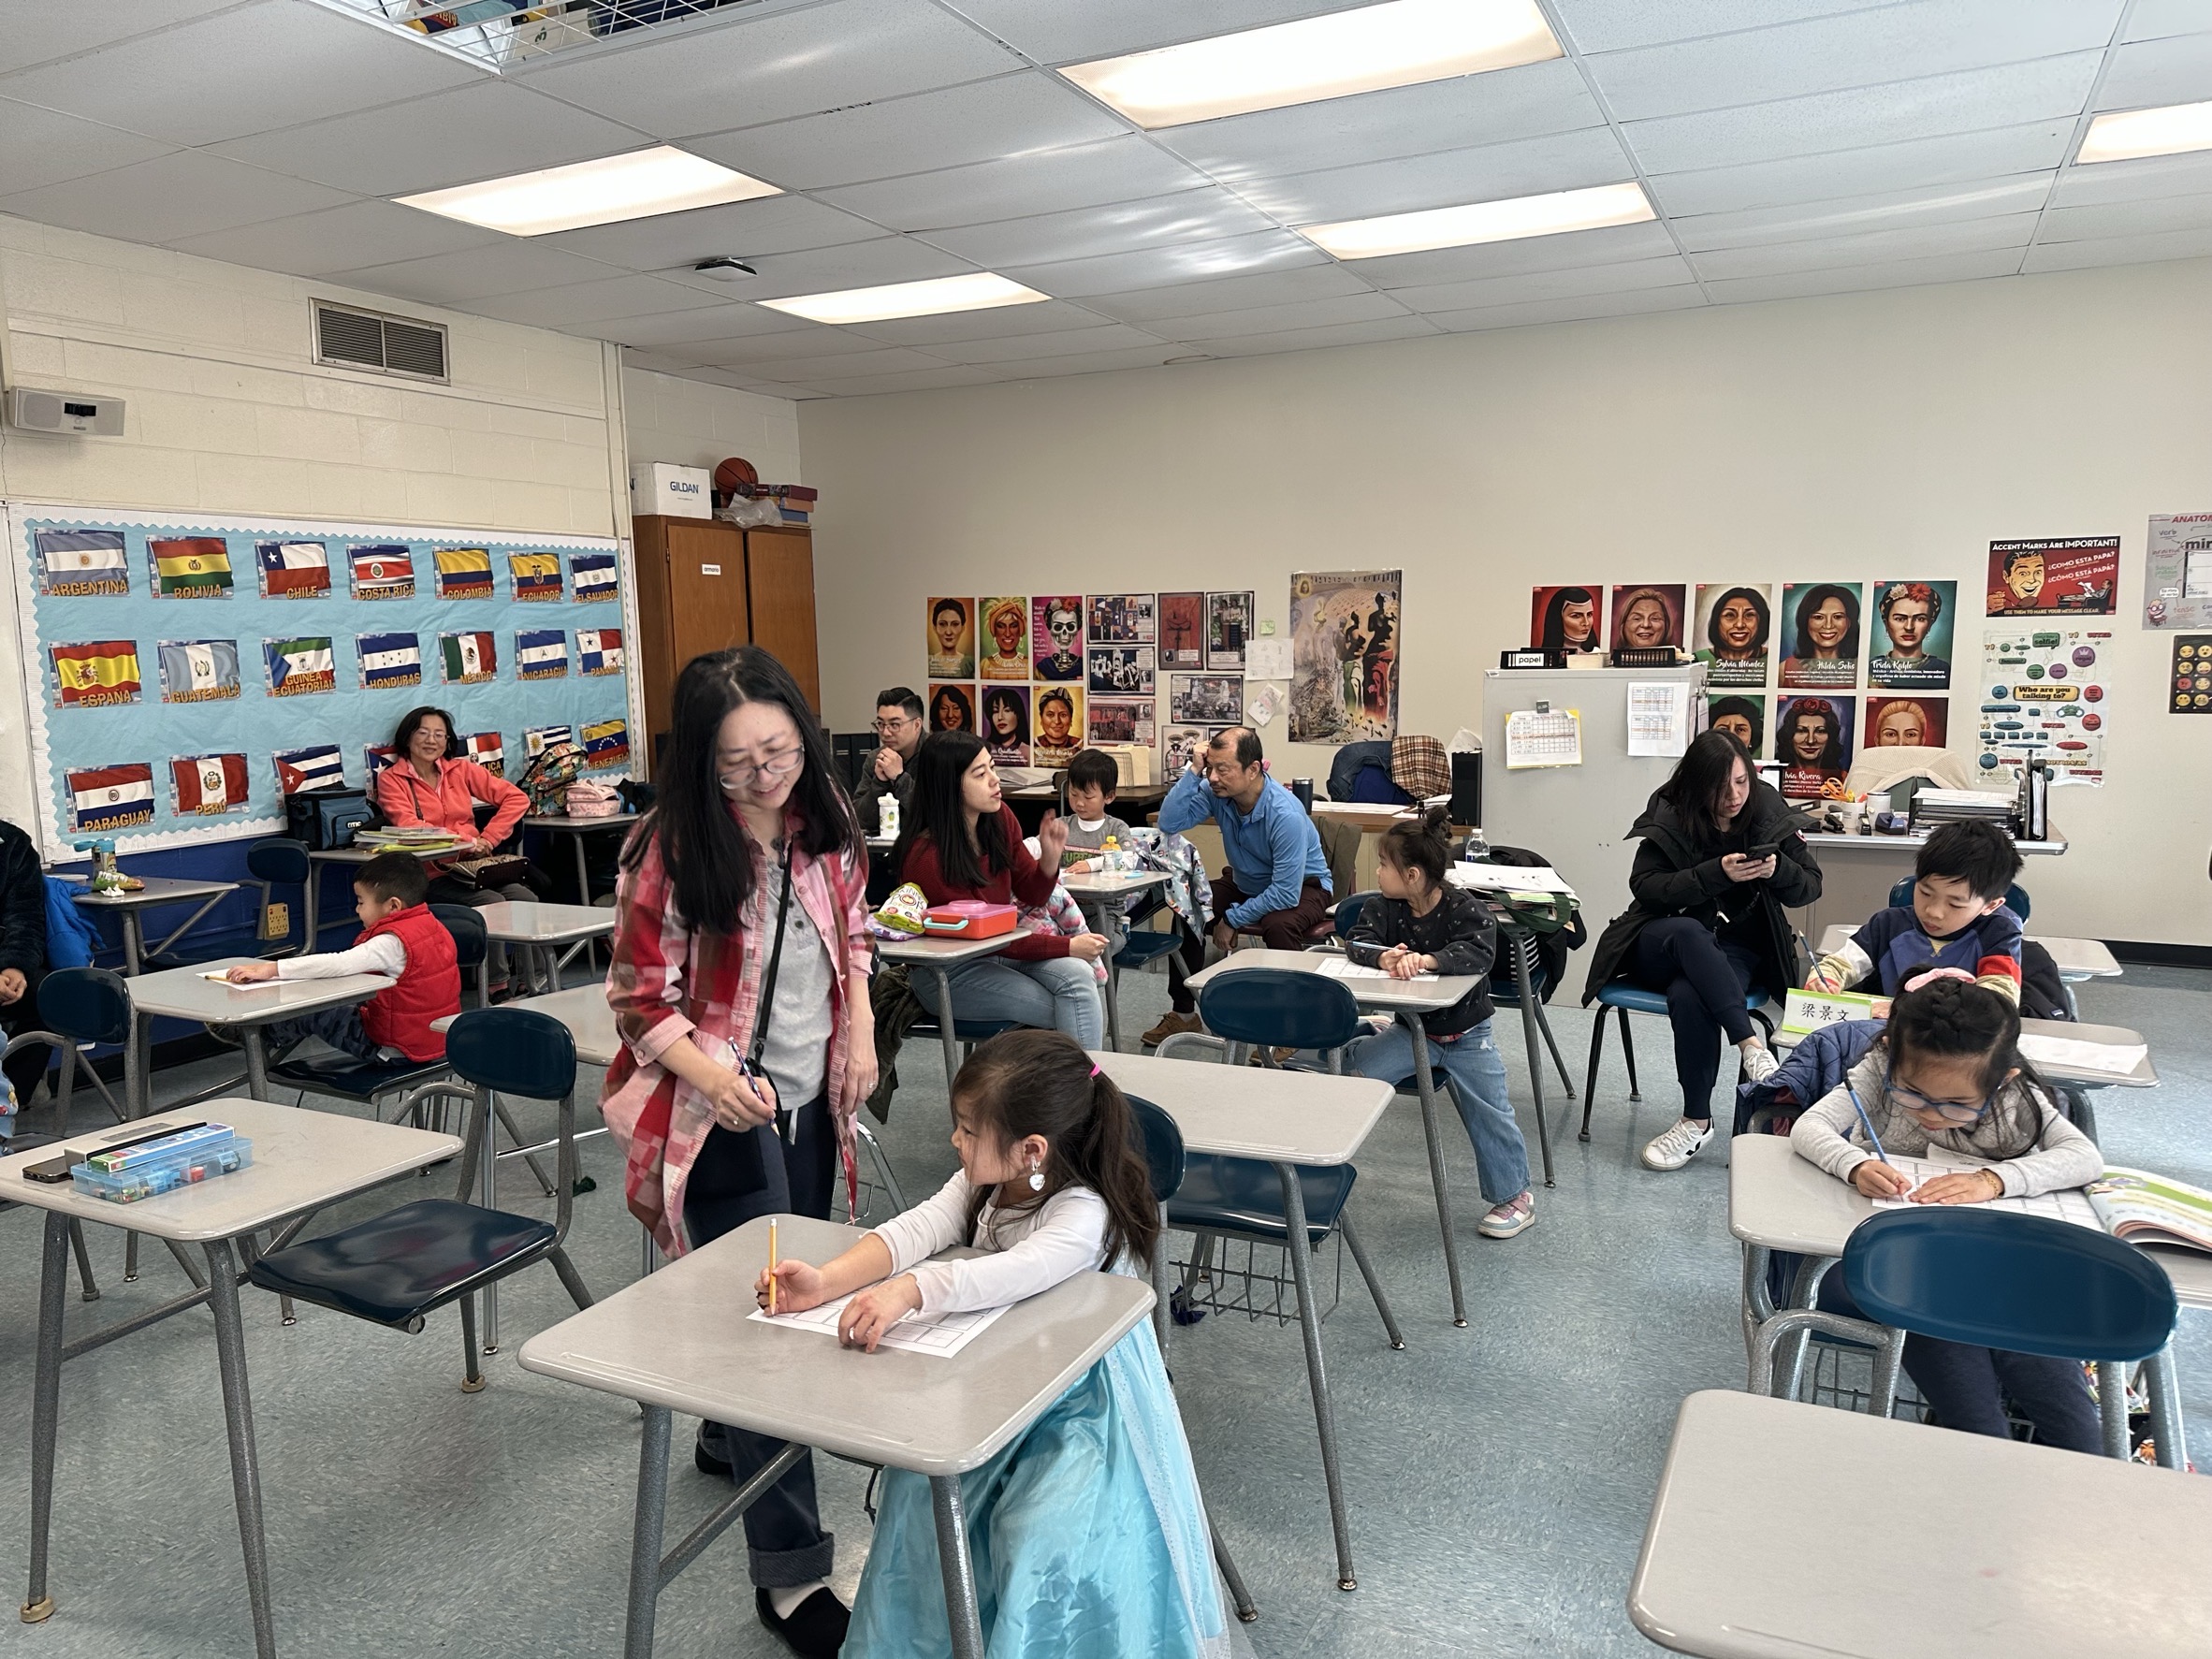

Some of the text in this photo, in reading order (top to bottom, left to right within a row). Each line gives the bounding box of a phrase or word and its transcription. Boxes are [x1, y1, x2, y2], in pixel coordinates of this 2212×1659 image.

[670, 481, 699, 494] GILDAN
[2064, 539, 2117, 548] IMPORTANT!
[2048, 560, 2074, 571] ¿COMO
[2074, 557, 2092, 565] ESTA
[2093, 551, 2115, 561] PAPA?
[2074, 567, 2092, 577] ESTÁ
[51, 579, 128, 597] ARGENTINA
[173, 583, 223, 599] BOLIVIA
[286, 585, 318, 599] CHILE
[358, 585, 415, 600] COSTA RICA
[447, 587, 493, 600] COLOMBIA
[522, 589, 560, 602] ECUADOR
[576, 589, 618, 603] EL SALVADOR
[1519, 656, 1541, 664] papel
[1715, 659, 1737, 670] Sylvia
[1816, 660, 1836, 670] Hilda
[1870, 659, 1913, 671] Frida Kahlo
[459, 670, 493, 684] MÉXICO
[523, 665, 567, 680] NICARAGUA
[273, 672, 334, 697] GUINEA ECUATORIAL
[370, 673, 421, 689] HONDURAS
[79, 689, 132, 707] ESPAÑA
[170, 684, 240, 704] GUATEMALA
[2022, 692, 2051, 701] talking
[589, 751, 629, 771] VENEZUELA
[1784, 770, 1821, 780] lvia Rivera
[195, 798, 227, 816] PERÚ
[84, 808, 151, 833] PARAGUAY
[1801, 1002, 1849, 1021] 梁景文
